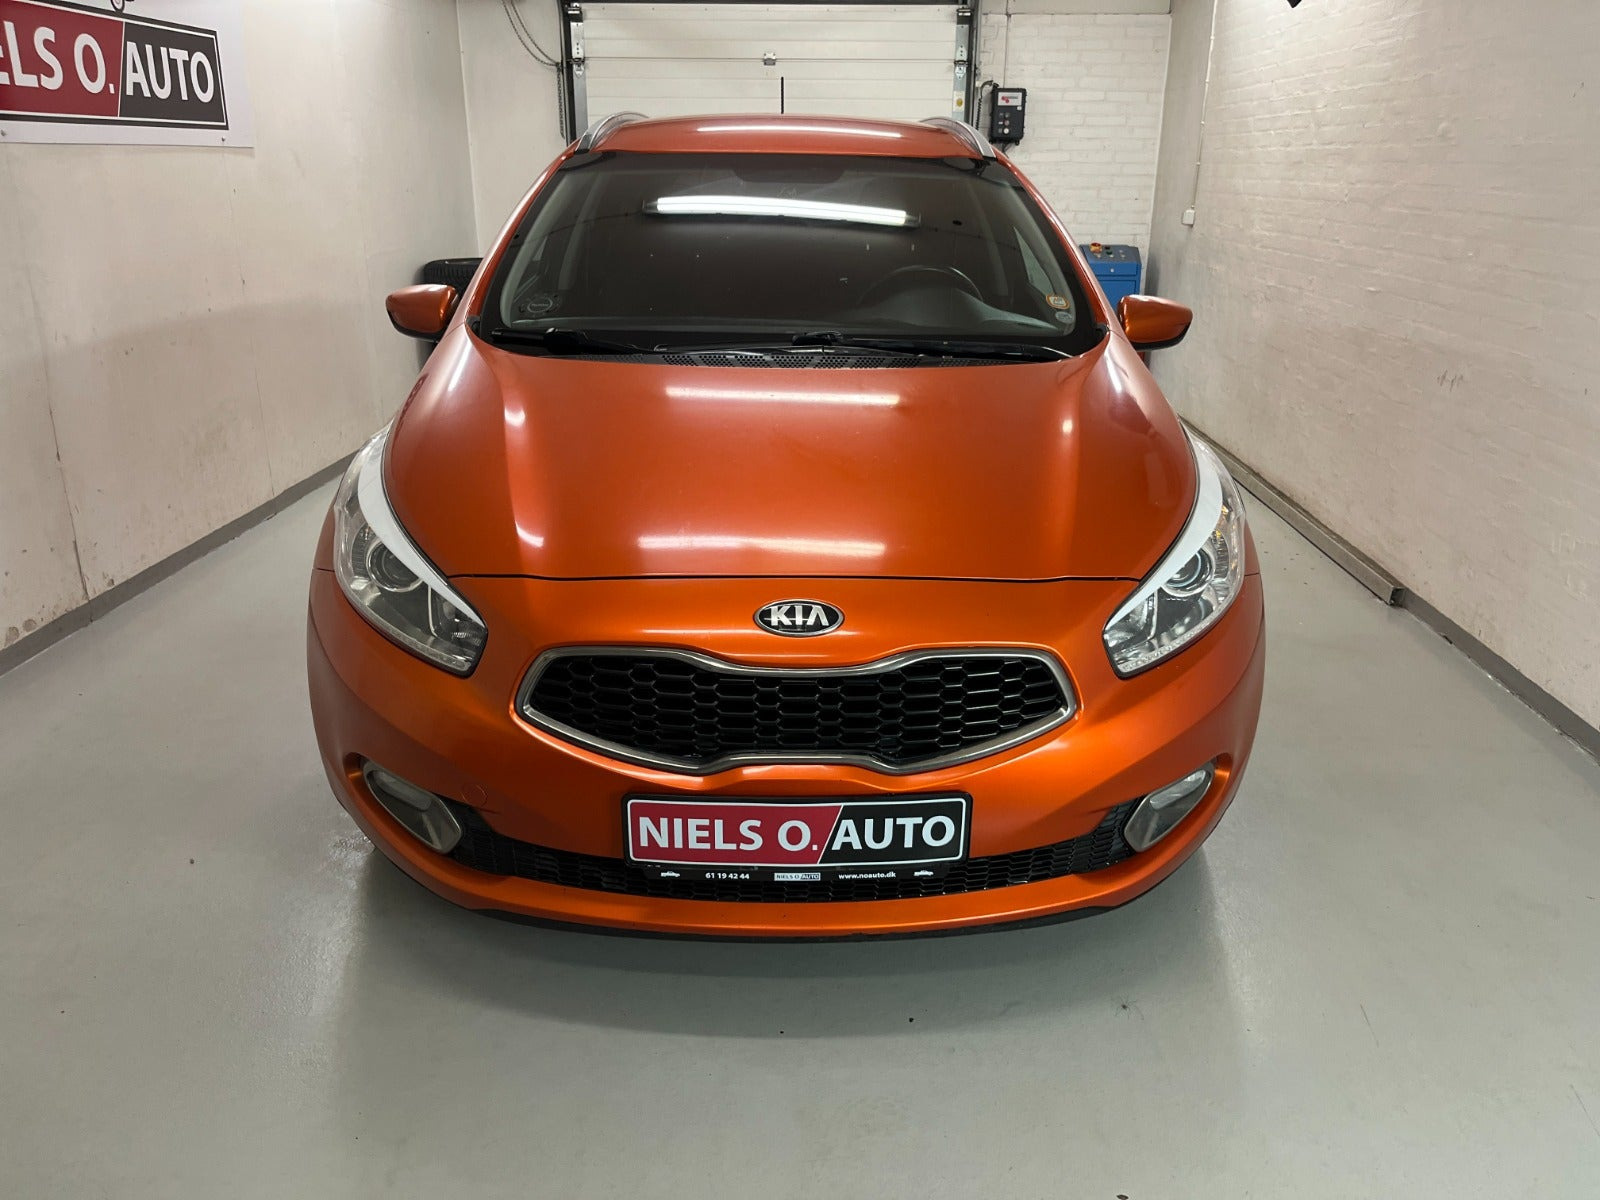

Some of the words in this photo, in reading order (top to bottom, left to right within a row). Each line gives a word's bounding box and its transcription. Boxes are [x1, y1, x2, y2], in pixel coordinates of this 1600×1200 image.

[74, 33, 115, 94] O.
[125, 41, 215, 103] AUTO
[769, 605, 830, 626] KIA
[638, 815, 764, 851] NIELS
[777, 820, 819, 852] O.
[831, 815, 956, 851] AUTO
[717, 872, 727, 880] 19
[838, 871, 897, 880] www.noauto.dk
